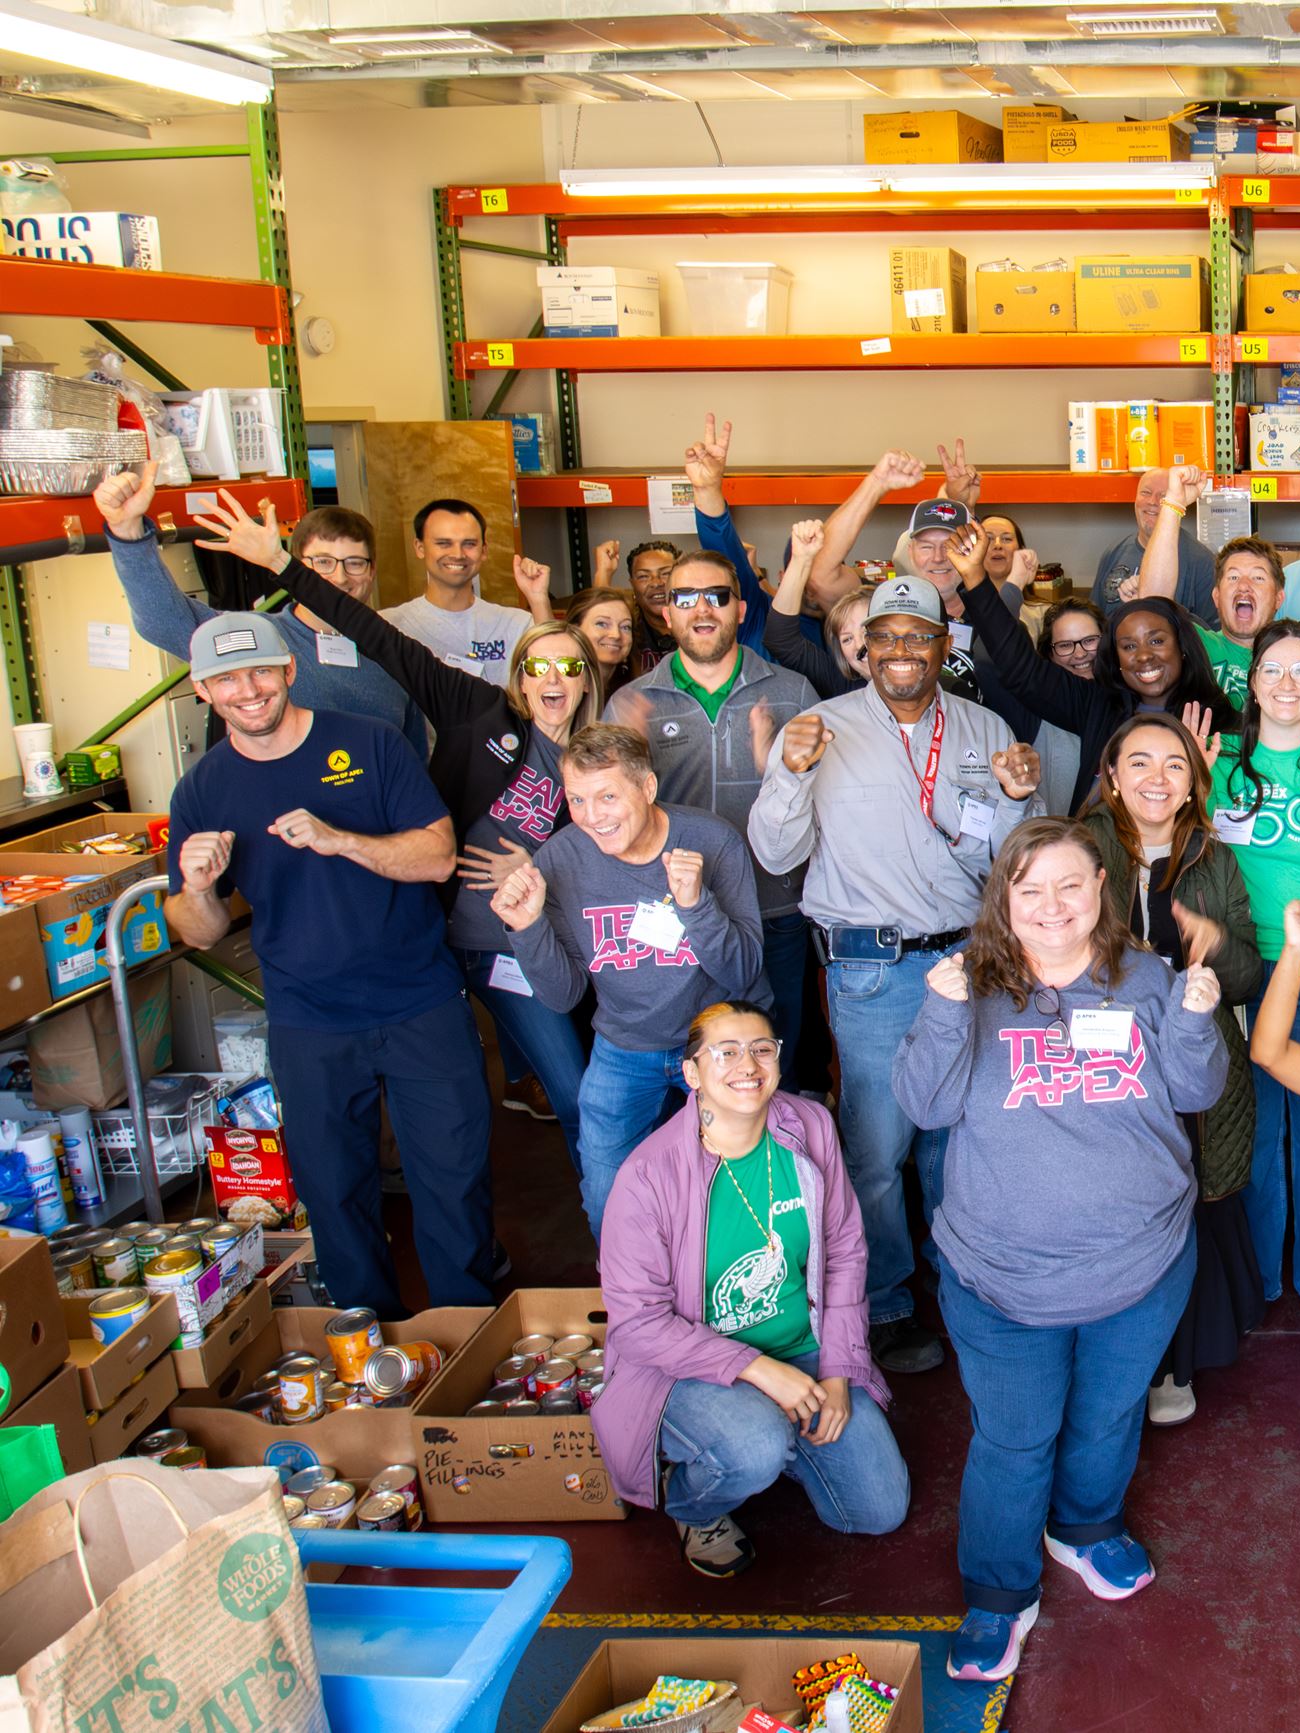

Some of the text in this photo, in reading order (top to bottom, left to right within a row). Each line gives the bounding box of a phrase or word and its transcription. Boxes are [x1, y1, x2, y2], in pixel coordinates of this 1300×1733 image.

[1245, 184, 1263, 196] U6
[482, 194, 499, 207] T6
[1092, 266, 1121, 277] ULINE
[1144, 268, 1165, 276] CLEAR
[488, 348, 505, 362] T5
[1181, 344, 1197, 356] T5
[1244, 343, 1261, 355] U5
[1253, 482, 1270, 494] U4
[471, 639, 505, 651] TEAM
[320, 768, 364, 784] TOWN OF APEX
[1003, 1046, 1149, 1109] APEX
[231, 1161, 260, 1170] IDAHOAN
[216, 1174, 283, 1188] Buttery Homestyle
[553, 1431, 586, 1440] MAX
[553, 1442, 585, 1452] FILL
[424, 1450, 453, 1468] PIE
[425, 1463, 506, 1486] FILLINGS
[222, 1543, 283, 1593] WHOLE
[230, 1559, 288, 1609] FOODS
[246, 1579, 284, 1613] MARKET
